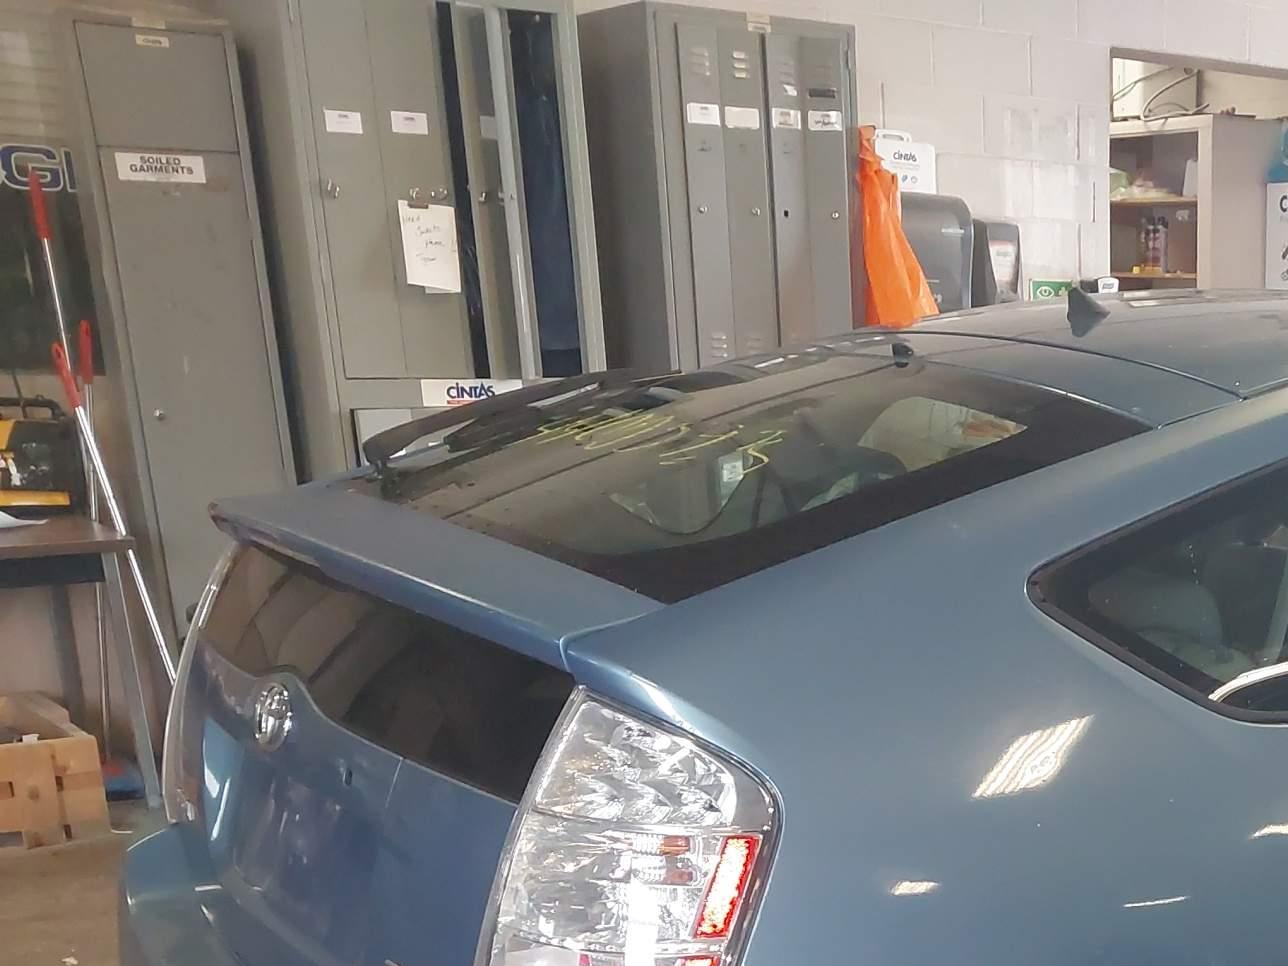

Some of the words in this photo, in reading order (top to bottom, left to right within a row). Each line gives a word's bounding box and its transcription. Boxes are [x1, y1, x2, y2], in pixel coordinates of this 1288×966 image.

[139, 155, 181, 166] SOILED
[129, 163, 194, 175] GARMENTS
[446, 382, 496, 399] CINTAS
